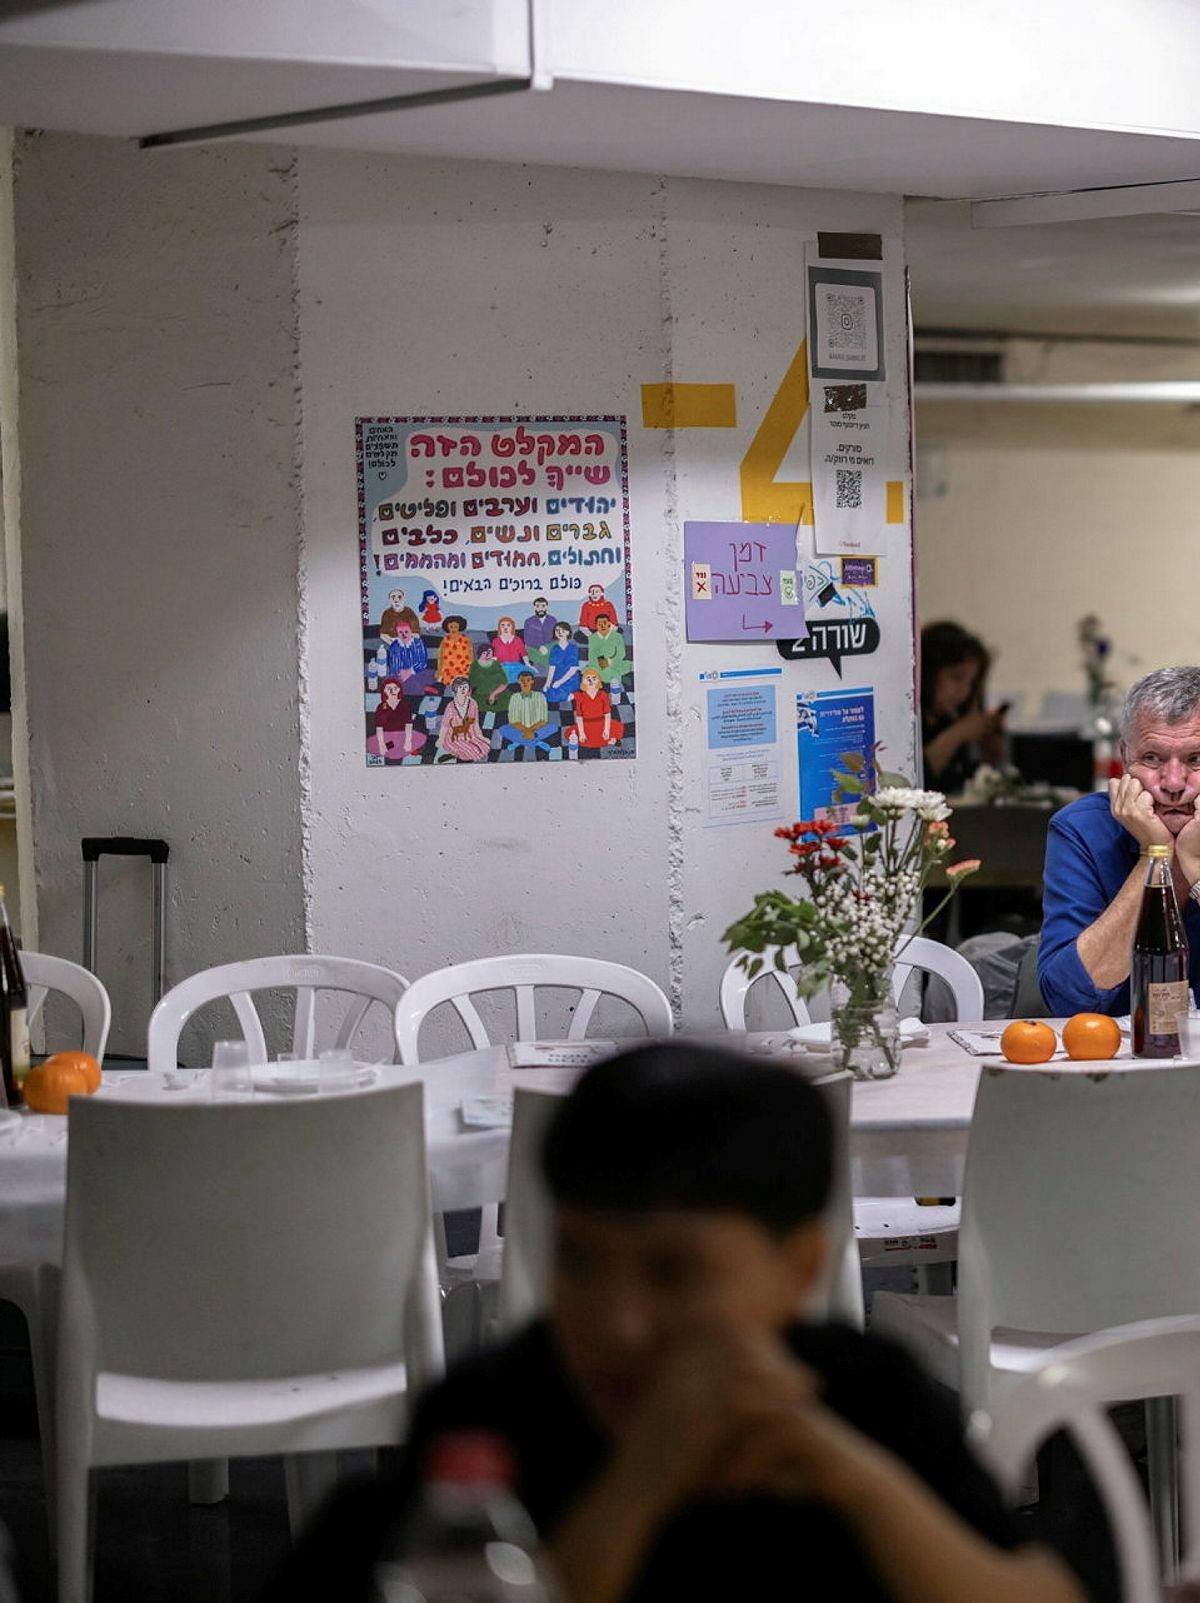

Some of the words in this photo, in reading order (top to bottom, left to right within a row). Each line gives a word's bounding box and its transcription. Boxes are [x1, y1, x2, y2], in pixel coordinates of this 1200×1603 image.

[410, 434, 482, 458] הזה
[491, 426, 605, 465] המקלט
[425, 460, 536, 489] לכולם:
[545, 464, 611, 491] שייך
[463, 496, 538, 518] וערבים
[545, 496, 617, 515] יהודים
[381, 524, 459, 546] כלבים
[546, 520, 613, 541] גברים
[373, 552, 467, 577] ומהממים!
[471, 550, 541, 570] חמודים
[729, 541, 767, 572] זמן
[443, 578, 491, 597] הבאים!
[499, 576, 543, 592] ברוכים
[550, 574, 582, 590] כולם
[711, 573, 773, 596] צביעה
[811, 623, 867, 652] שורה
